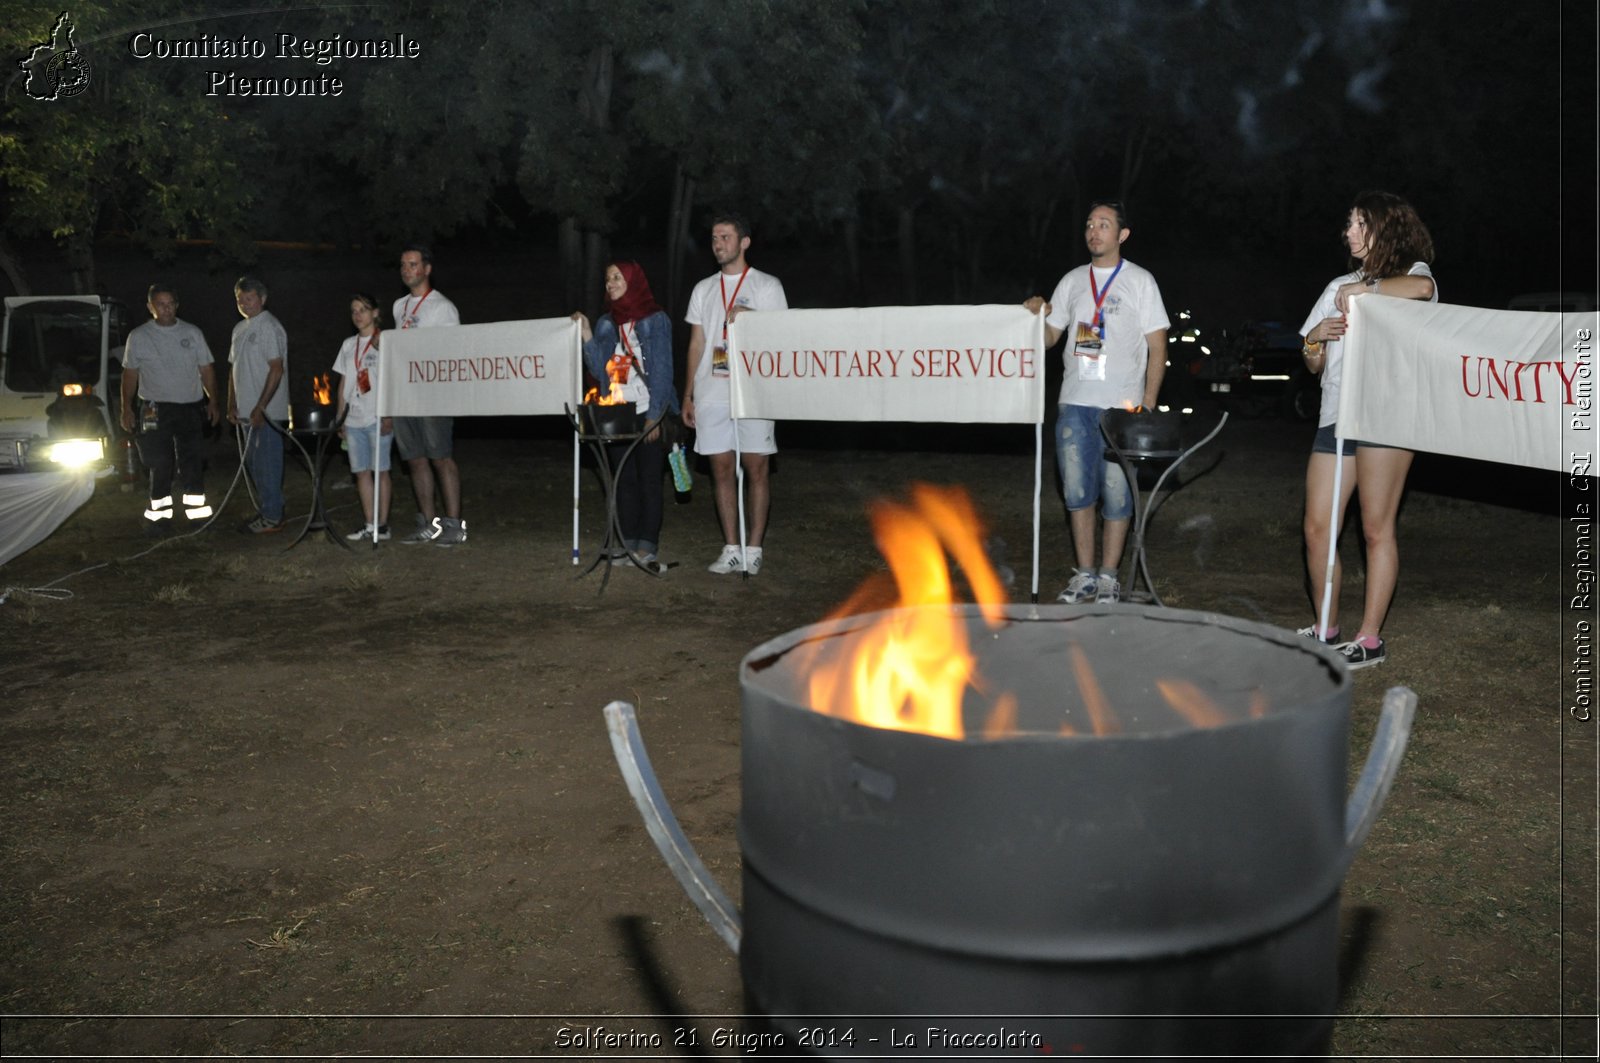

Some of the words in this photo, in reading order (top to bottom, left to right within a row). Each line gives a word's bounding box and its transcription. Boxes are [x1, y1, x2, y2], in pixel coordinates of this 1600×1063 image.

[408, 355, 547, 383] INDEPENDENCE
[739, 349, 904, 379] VOLUNTARY
[911, 348, 1037, 379] SERVICE
[1460, 354, 1587, 404] UNITY
